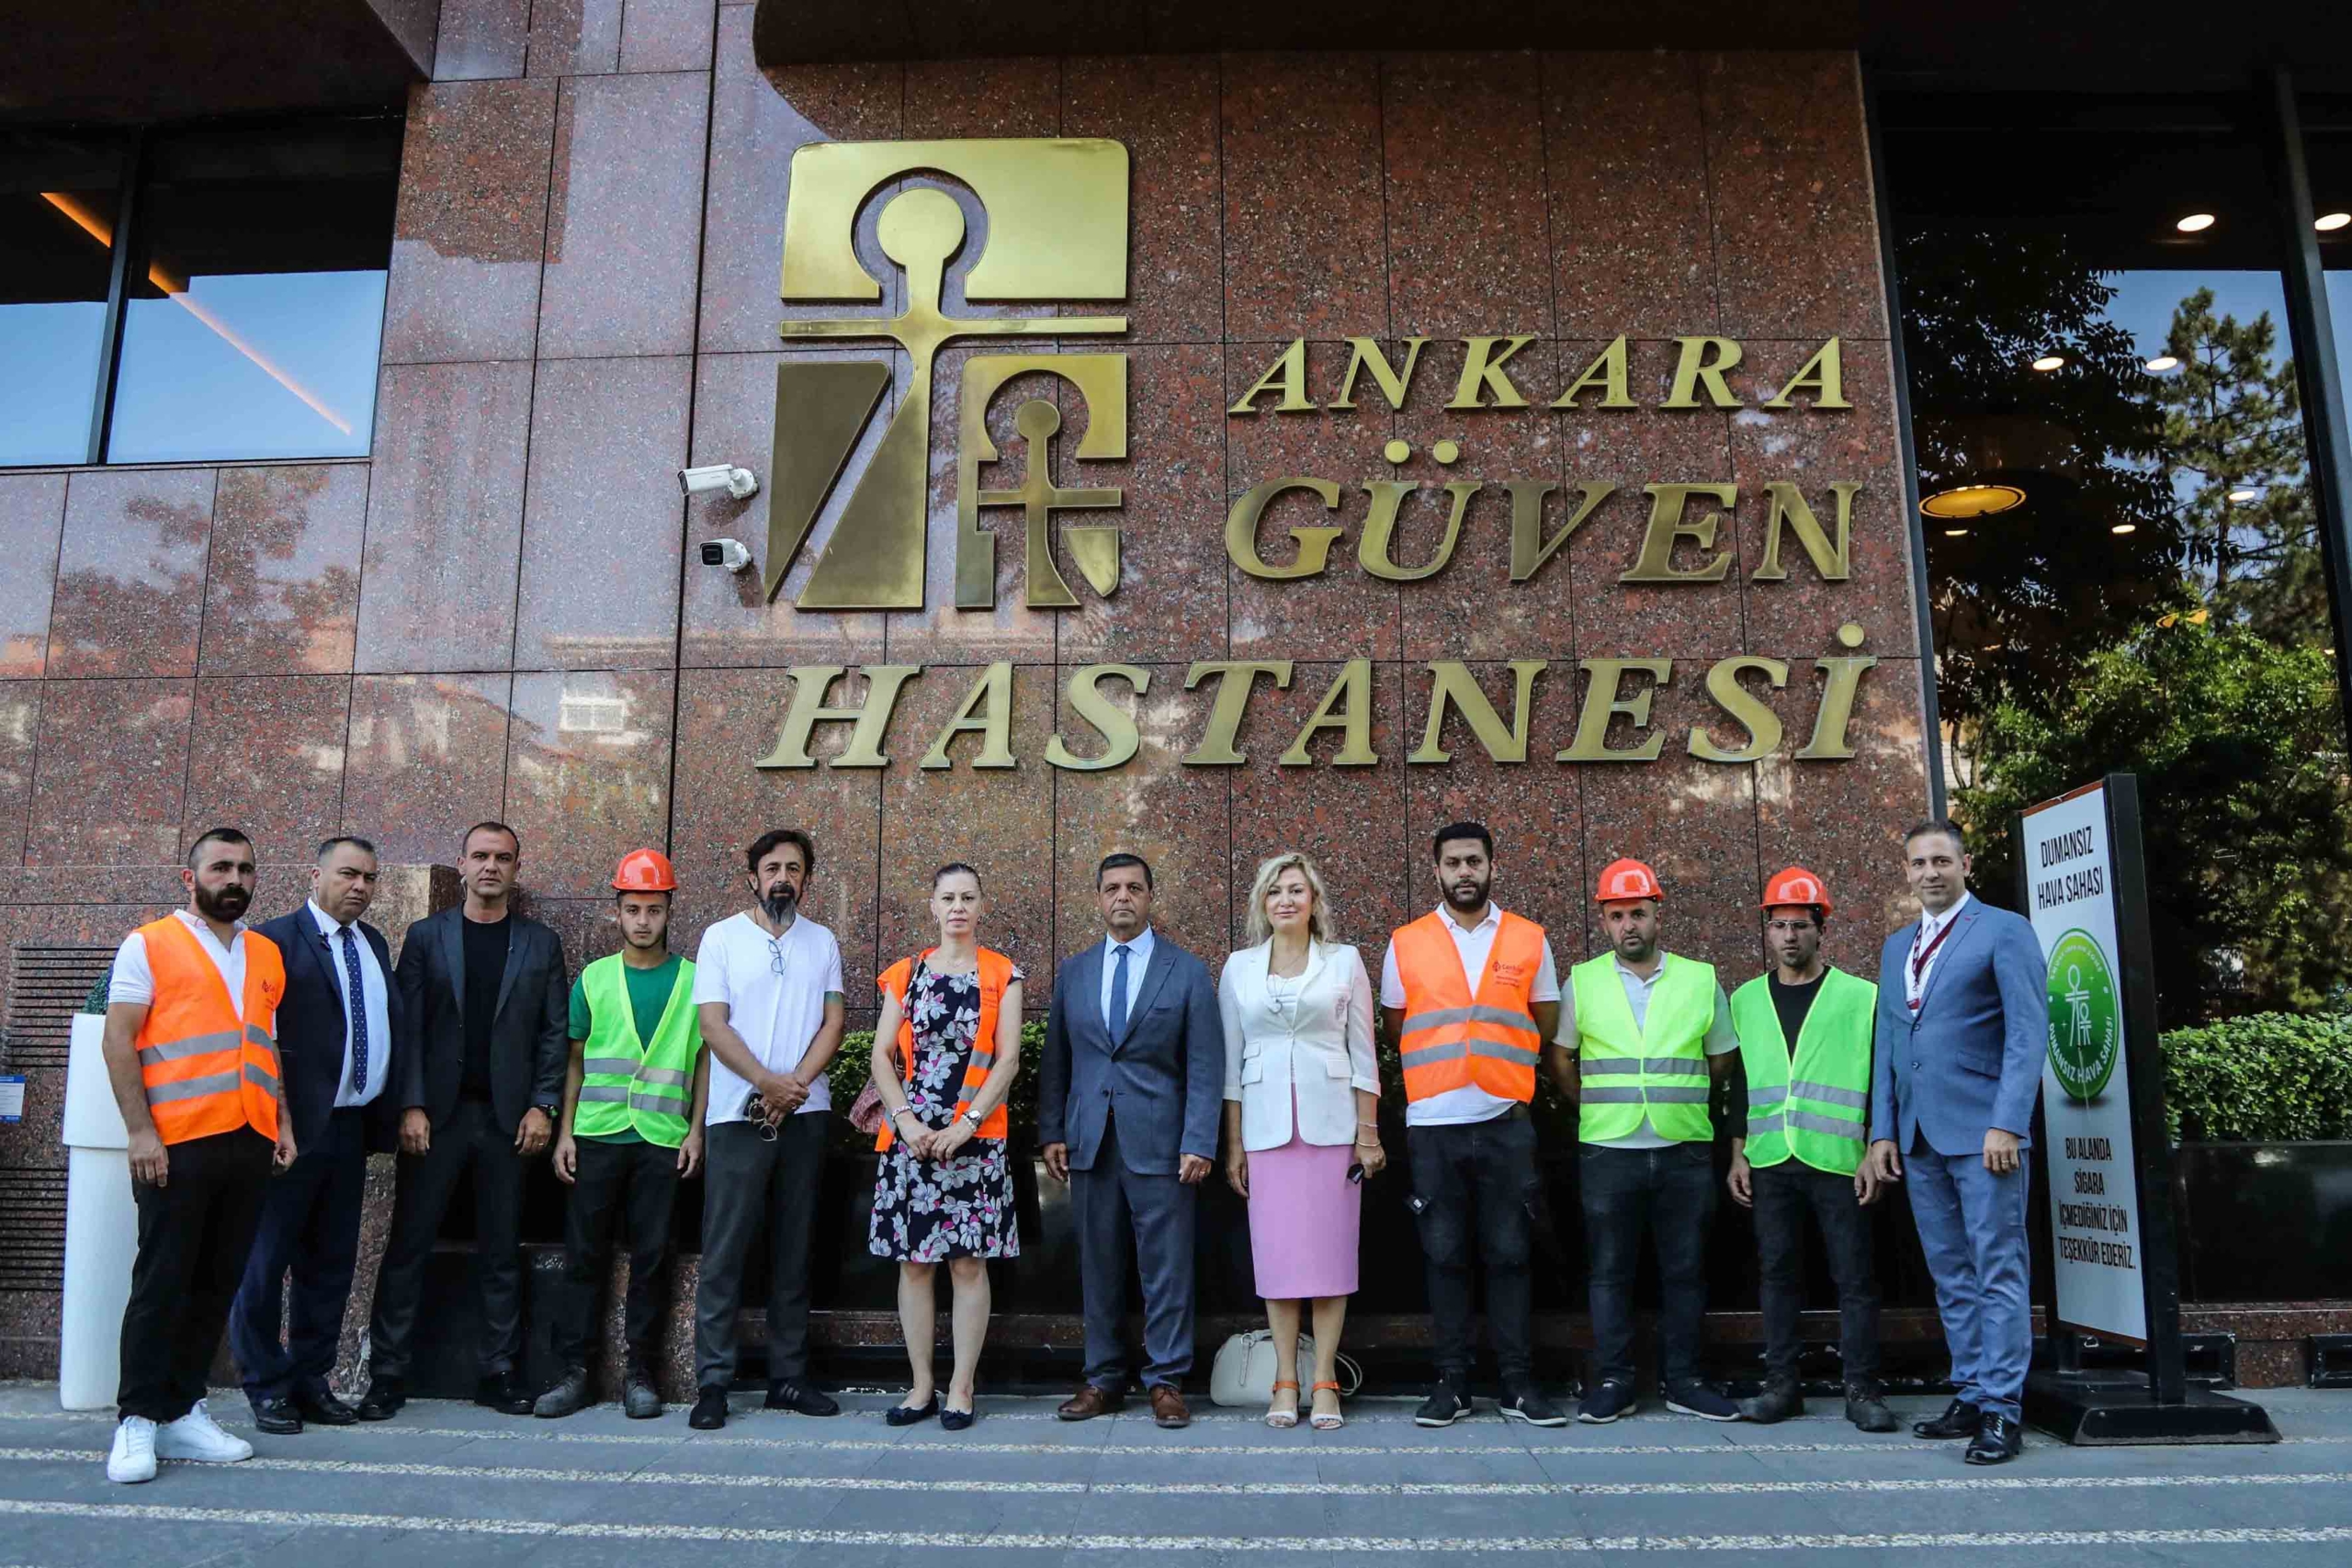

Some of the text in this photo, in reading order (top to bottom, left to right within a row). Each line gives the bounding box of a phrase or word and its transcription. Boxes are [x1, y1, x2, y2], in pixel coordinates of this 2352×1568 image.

[1227, 334, 1854, 412] ANKARA
[1225, 439, 1863, 583] GÜVEN
[754, 624, 1879, 771] HASTANESİ
[2041, 826, 2093, 868] DUMANSIZ
[2038, 865, 2103, 909] HAVA SAHASI
[2049, 1015, 2113, 1084] DUMANSIZ HAVA SAHASI
[2065, 1137, 2112, 1161] BU ALANDA
[2074, 1168, 2105, 1195] SİGARA
[2058, 1199, 2128, 1235] İÇMEDİĞİNİZ İÇİN
[2058, 1235, 2136, 1269] TEŞEKKÜR EDERİZ.
